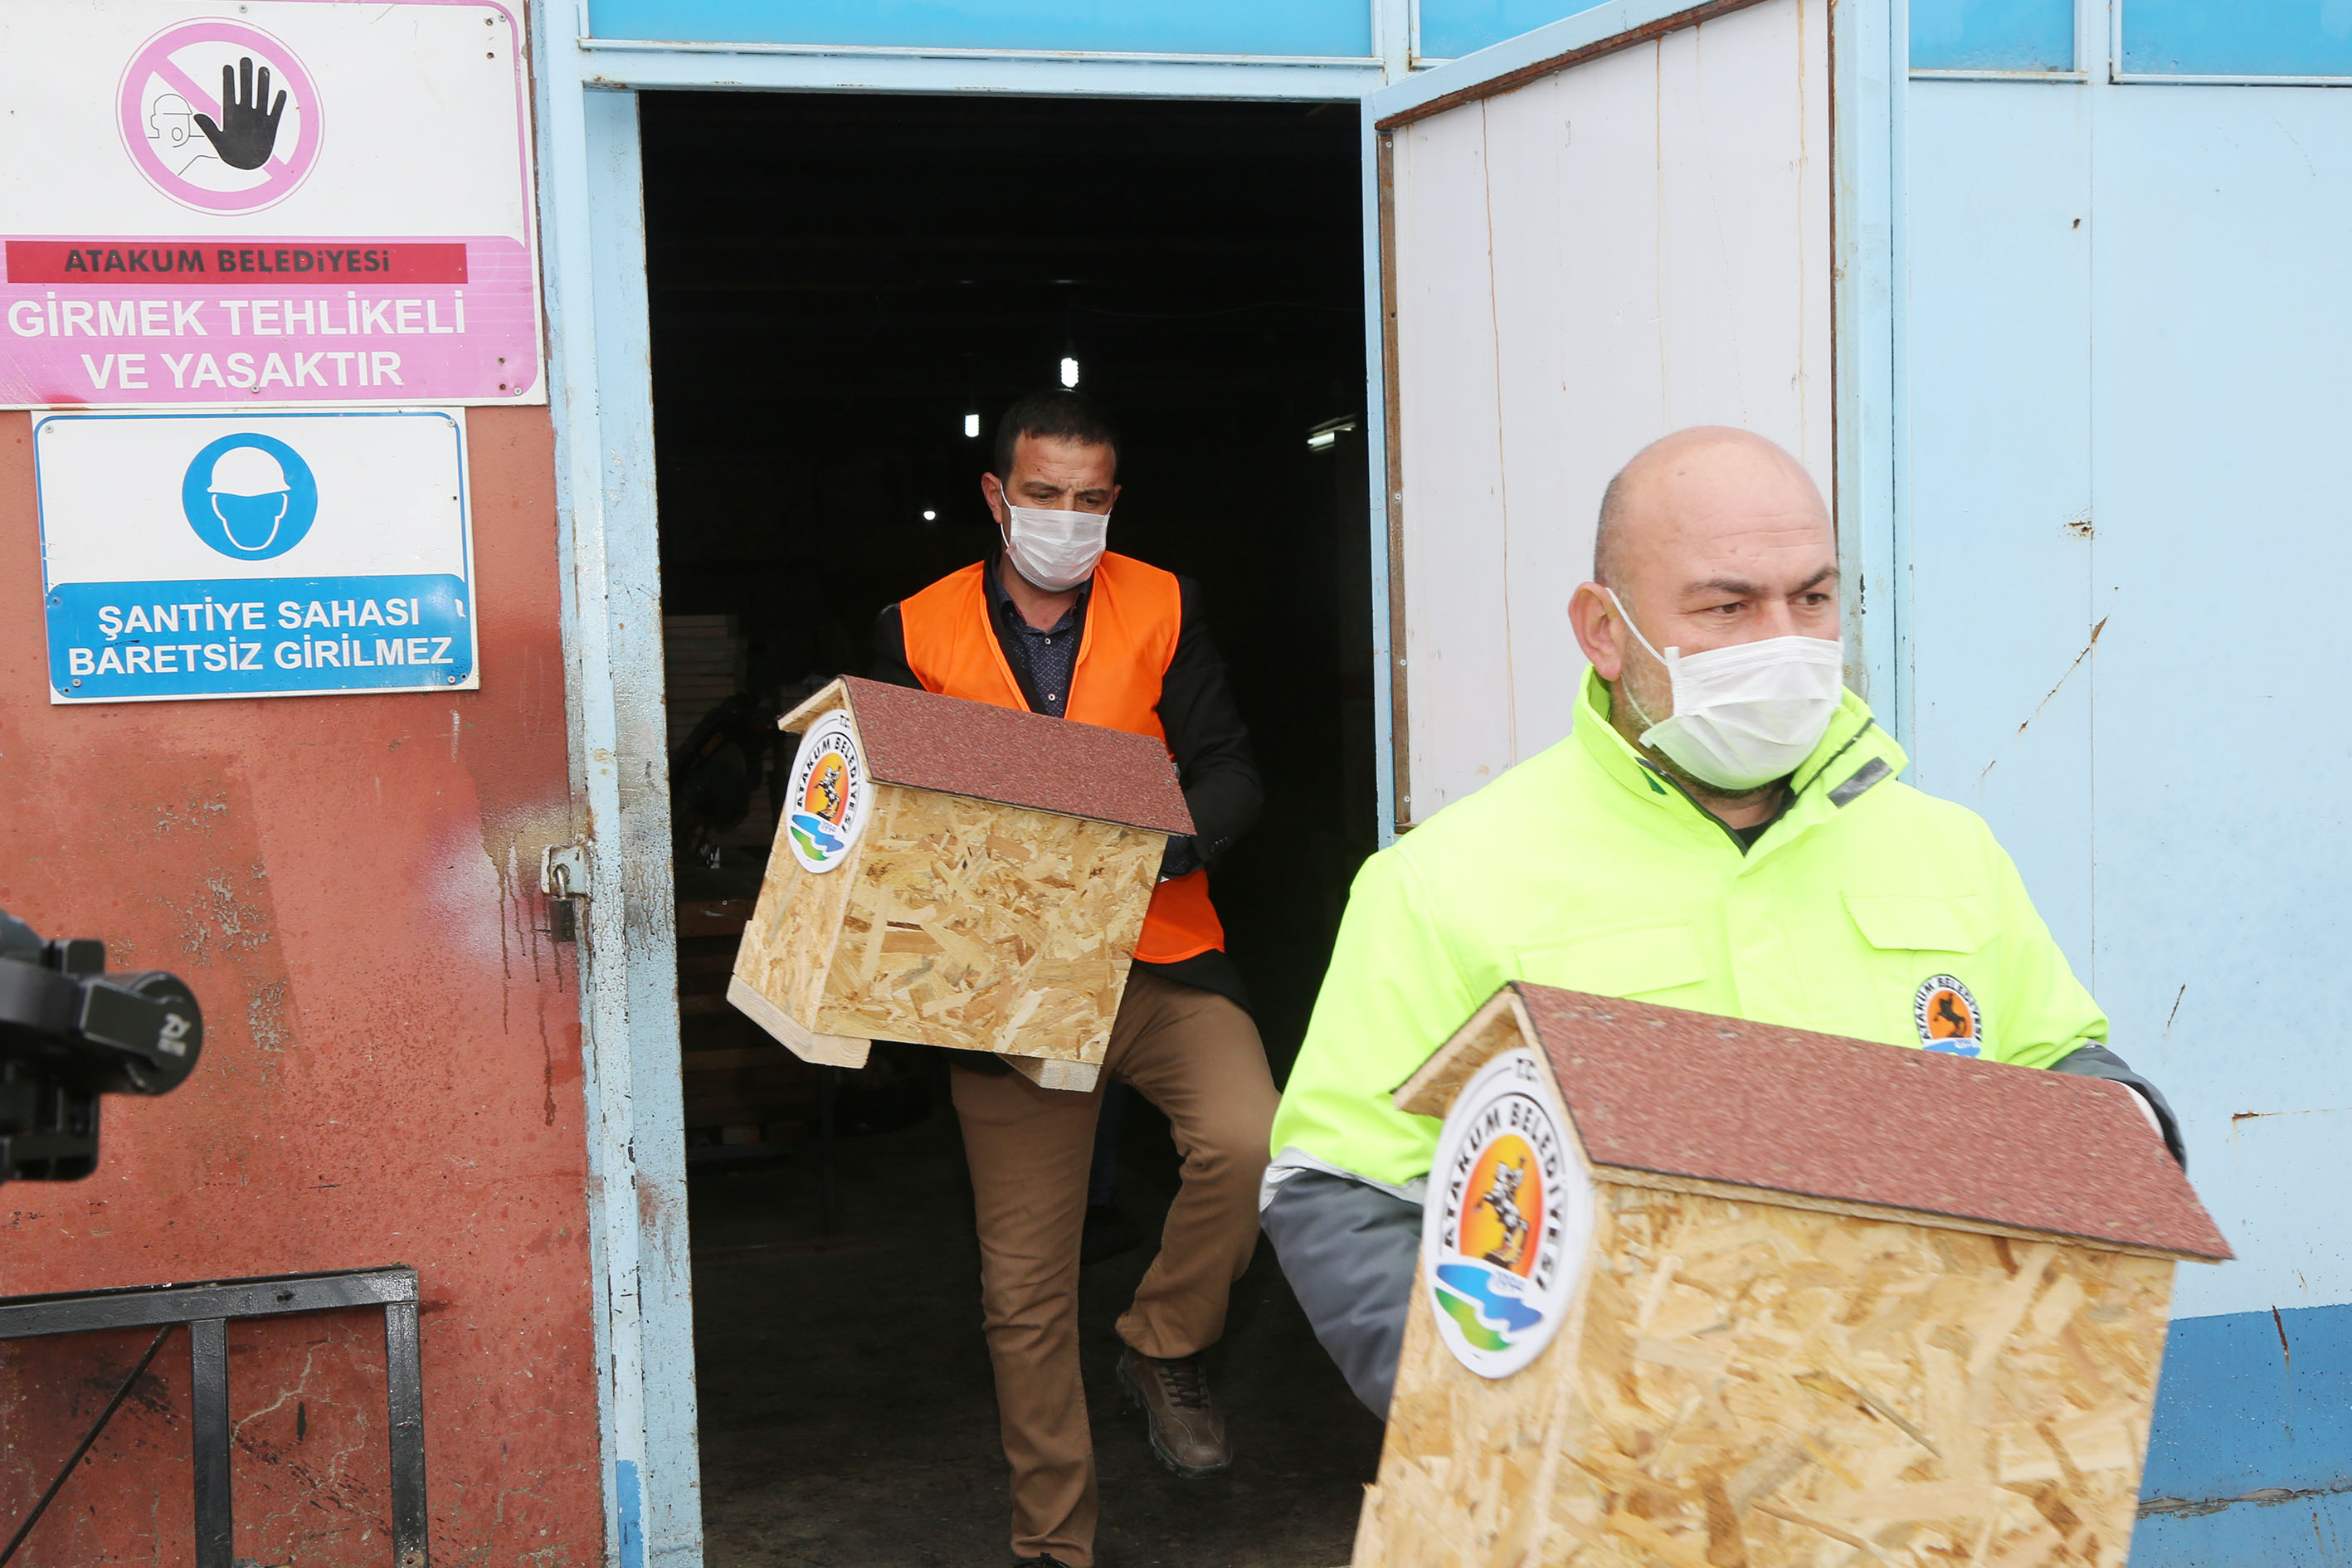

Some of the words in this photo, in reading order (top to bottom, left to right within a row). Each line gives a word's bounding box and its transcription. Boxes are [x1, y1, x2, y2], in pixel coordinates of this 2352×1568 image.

[64, 248, 206, 273] ATAKUM
[7, 290, 208, 338] GİRMEK
[221, 290, 465, 336] TEHLİKELİ
[81, 353, 145, 389] VE
[160, 351, 404, 387] YASAKTIR
[98, 597, 266, 639] ŞANTİYE
[277, 598, 419, 628] SAHASI
[69, 639, 264, 675] BARETSİZ
[274, 633, 455, 670] GİRİLMEZ
[796, 738, 830, 807] ATAKUM
[1444, 1107, 1501, 1248] ATAKUM
